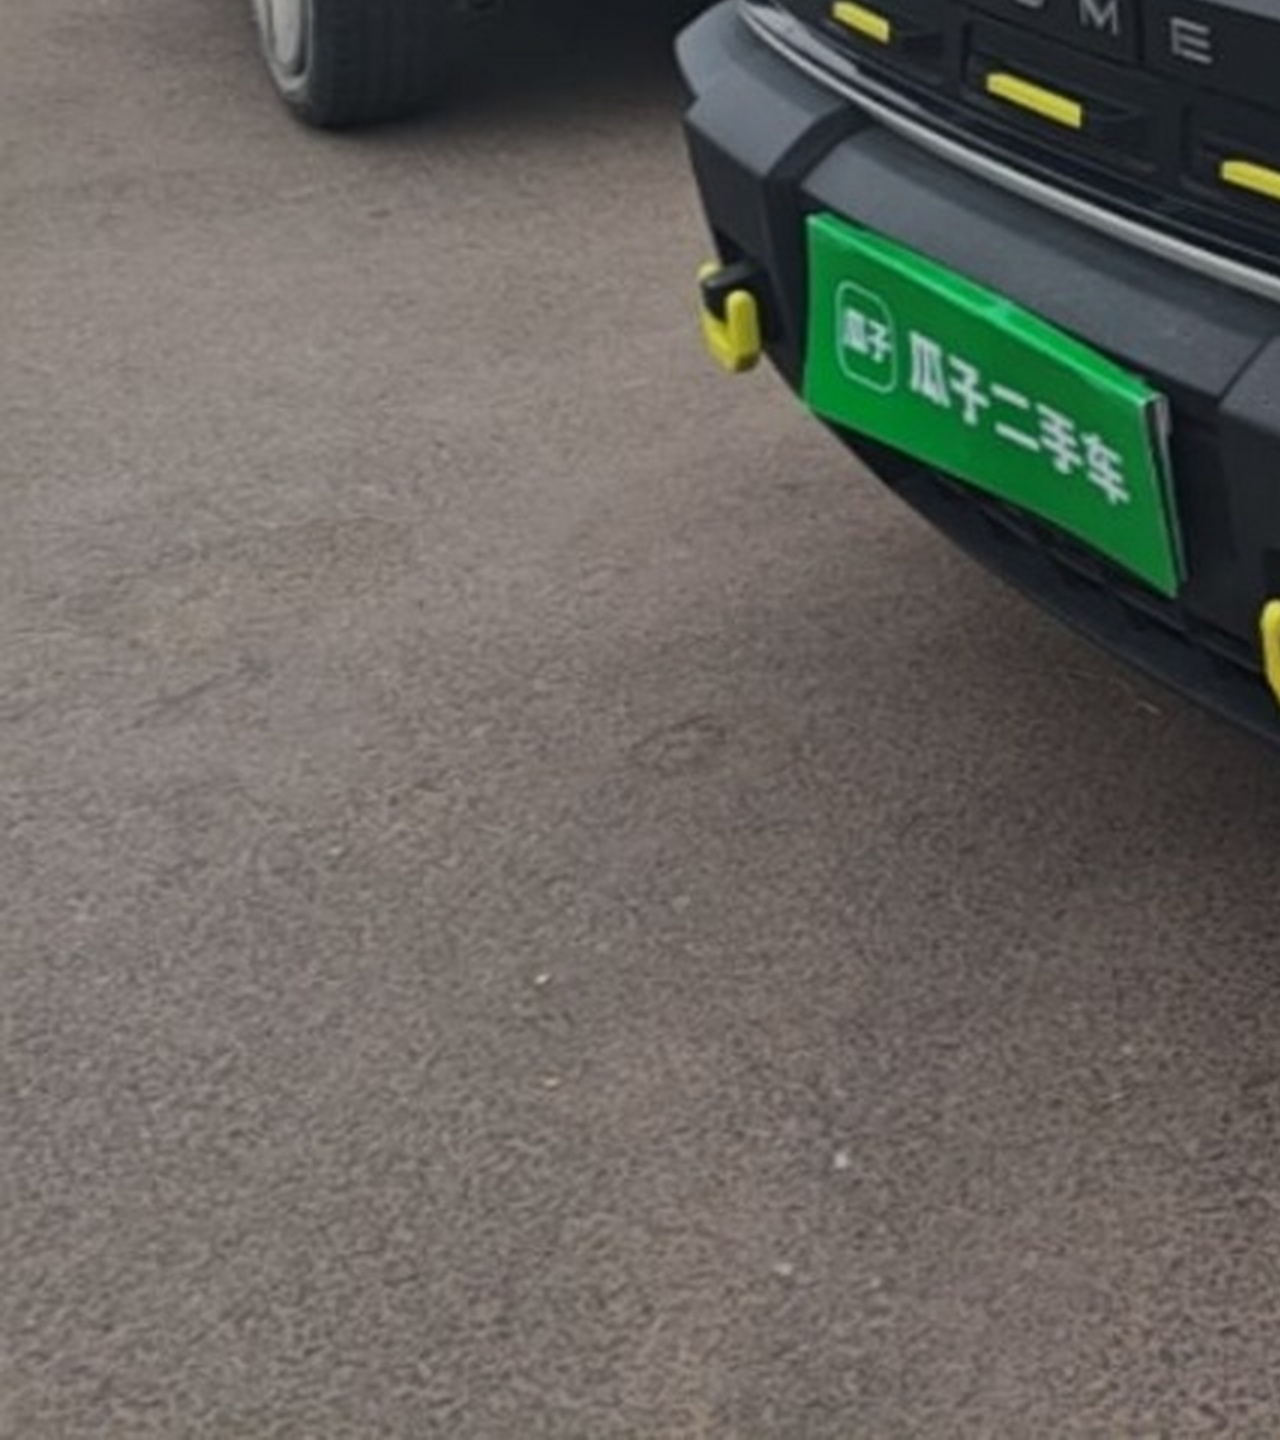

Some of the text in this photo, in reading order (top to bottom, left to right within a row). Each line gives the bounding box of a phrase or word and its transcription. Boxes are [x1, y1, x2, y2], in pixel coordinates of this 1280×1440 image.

[842, 308, 892, 364] 瓜子
[908, 330, 1130, 506] 瓜子二手车
